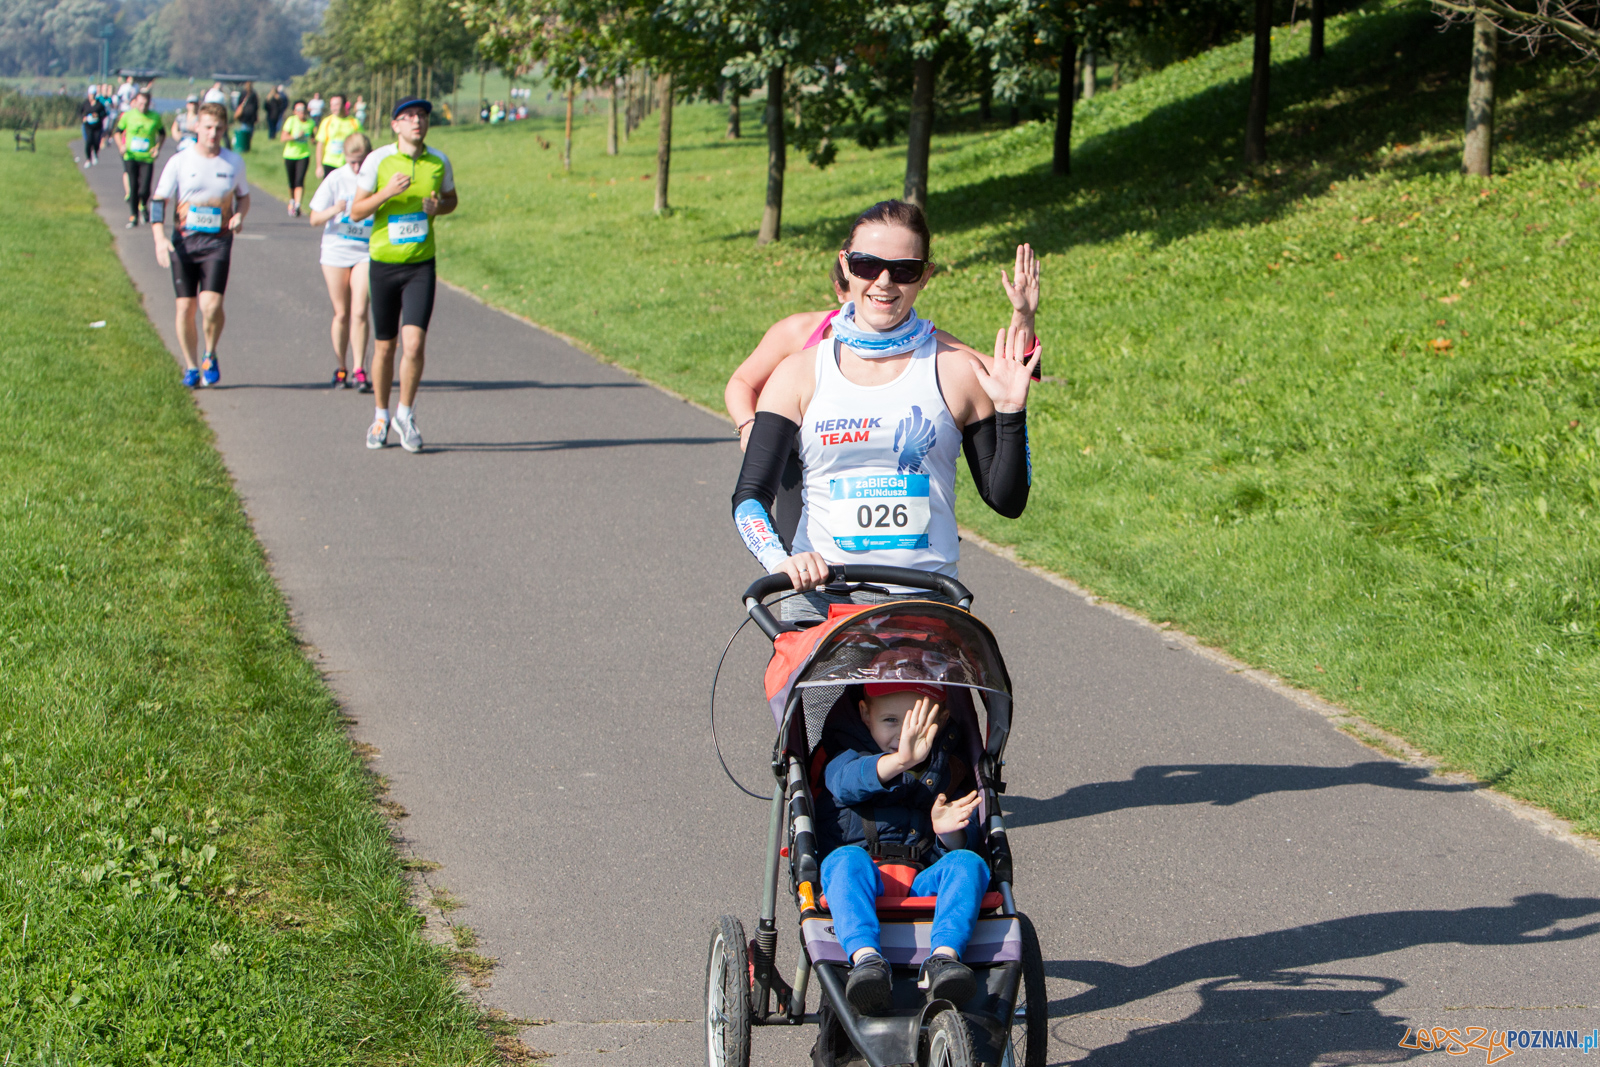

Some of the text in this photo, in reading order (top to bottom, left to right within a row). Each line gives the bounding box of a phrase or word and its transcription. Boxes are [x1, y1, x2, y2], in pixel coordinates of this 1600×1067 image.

[815, 417, 882, 433] HERNIK
[820, 431, 870, 446] TEAM
[855, 477, 907, 489] zaBIEGaj
[863, 488, 907, 497] FUNdusze
[857, 504, 908, 528] 026
